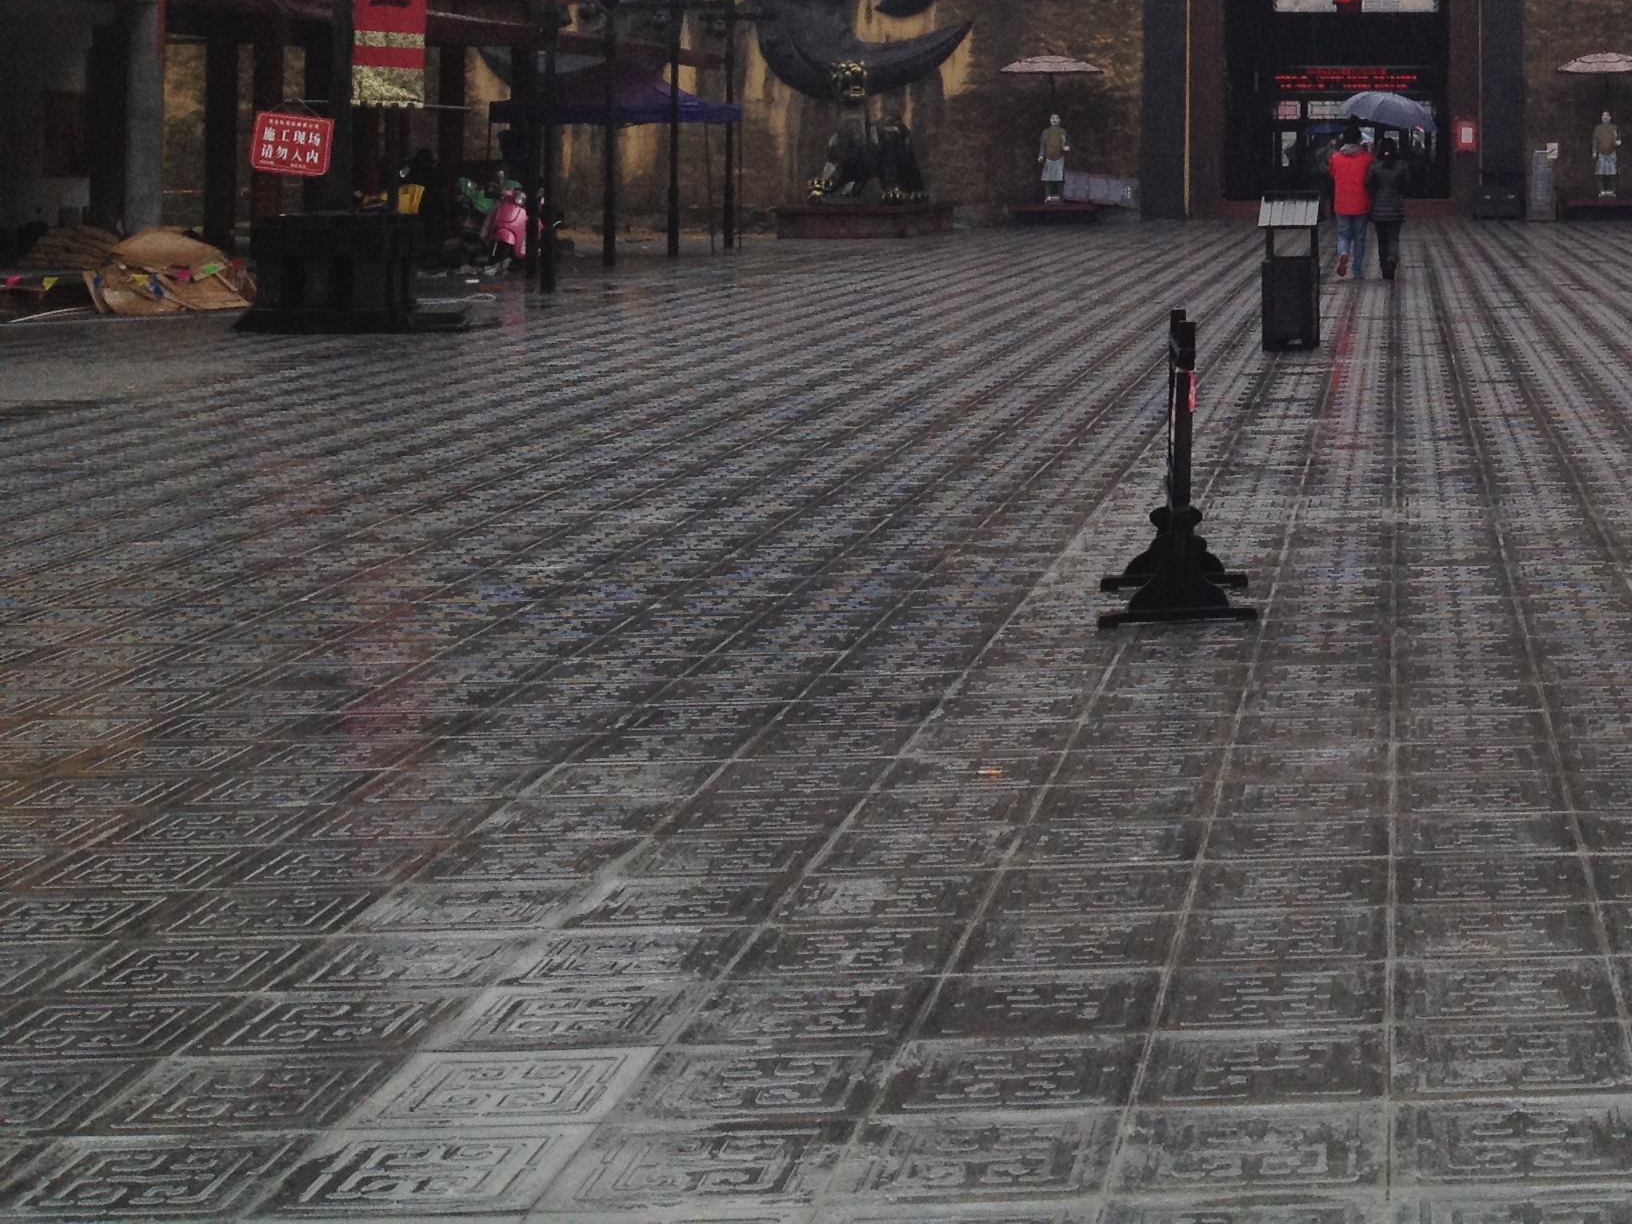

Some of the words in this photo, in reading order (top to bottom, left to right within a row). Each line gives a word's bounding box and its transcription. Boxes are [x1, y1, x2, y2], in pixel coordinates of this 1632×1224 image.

[262, 126, 321, 147] 施工现场
[261, 144, 320, 164] 请勿入内
